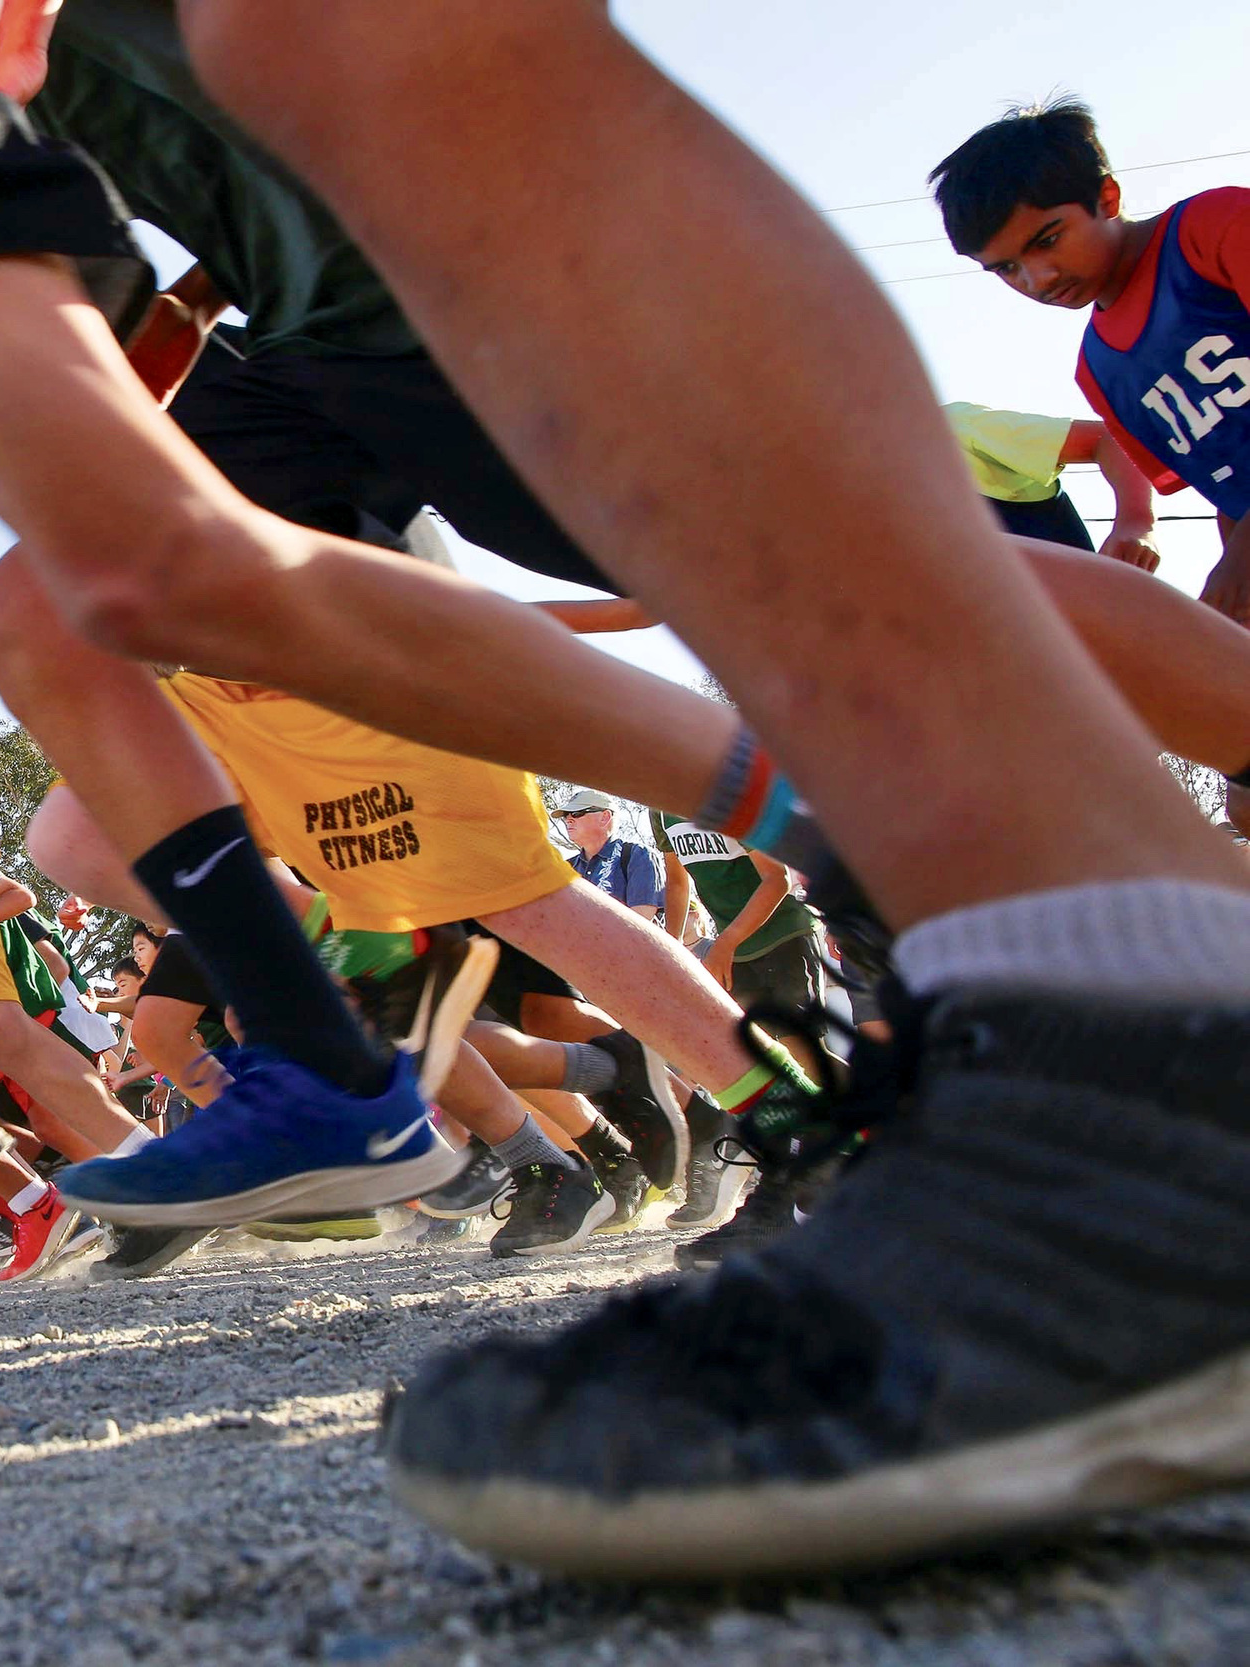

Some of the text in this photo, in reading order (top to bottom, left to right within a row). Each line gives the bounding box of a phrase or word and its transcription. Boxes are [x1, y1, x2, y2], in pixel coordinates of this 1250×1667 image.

[1141, 334, 1250, 455] JLS
[303, 782, 414, 834] PHYSICAL
[318, 820, 420, 870] FITNESS
[671, 832, 730, 857] JORDAN
